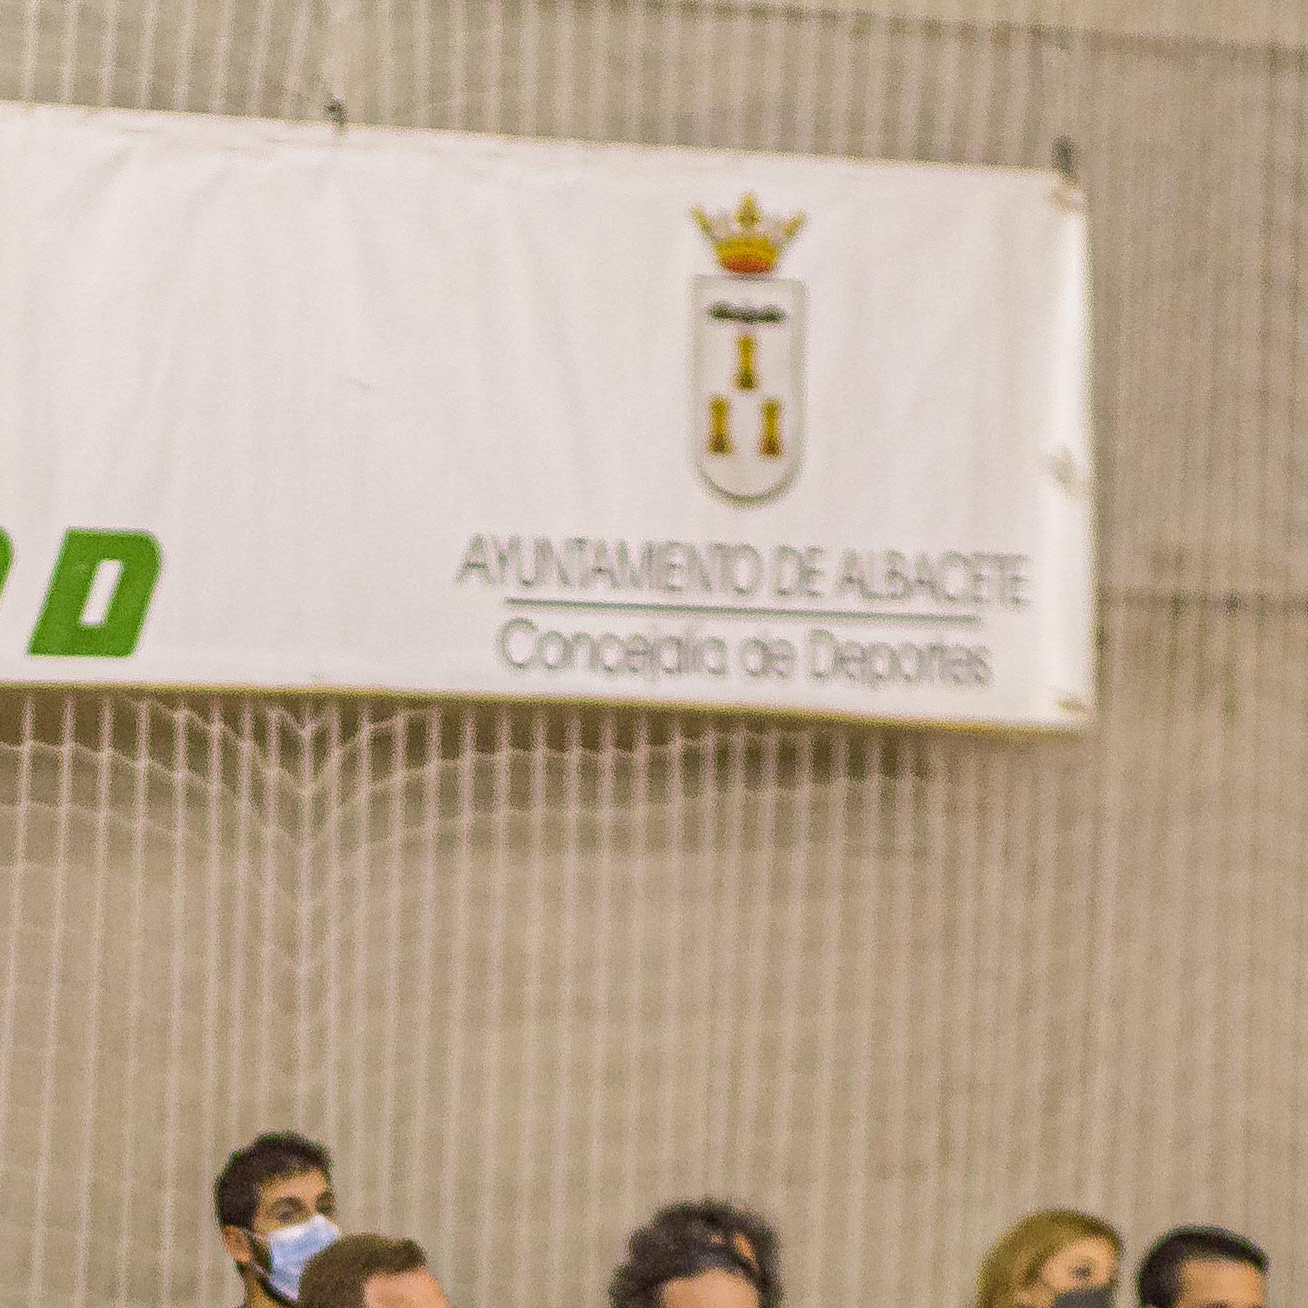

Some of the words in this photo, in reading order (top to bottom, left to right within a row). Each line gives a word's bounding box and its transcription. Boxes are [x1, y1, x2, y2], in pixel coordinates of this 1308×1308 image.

[456, 533, 762, 597] AYUNTAMIENTO
[771, 543, 825, 599] DE
[835, 548, 1031, 609] ALBACETE
[738, 634, 796, 682] de
[803, 628, 992, 688] Deportes
